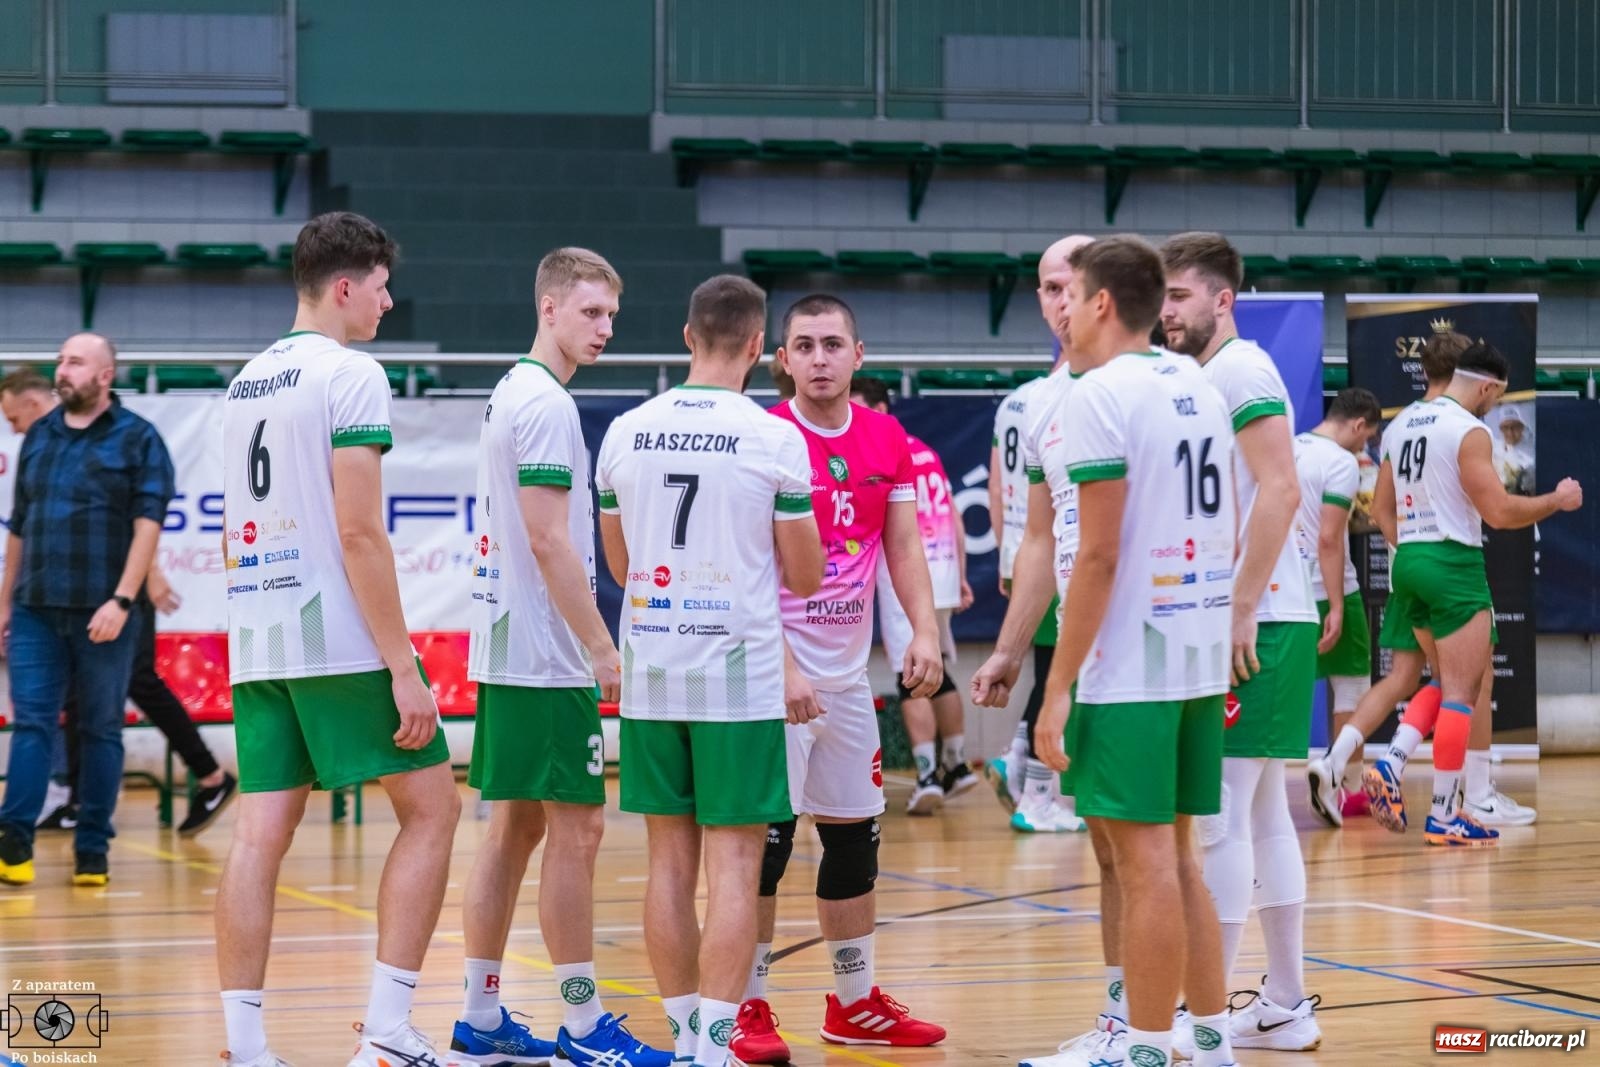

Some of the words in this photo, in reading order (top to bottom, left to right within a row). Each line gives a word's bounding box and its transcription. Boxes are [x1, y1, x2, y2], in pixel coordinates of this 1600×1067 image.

[247, 419, 271, 502] 6
[634, 432, 739, 454] BŁASZCZOK
[1005, 426, 1018, 473] 8
[1398, 436, 1427, 483] 49
[916, 472, 950, 518] 42
[1175, 437, 1220, 519] 16
[664, 473, 699, 550] 7
[831, 490, 855, 527] 15
[806, 600, 865, 615] PIVEXIN
[806, 615, 863, 626] TECHNOLOGY
[586, 733, 604, 776] 3
